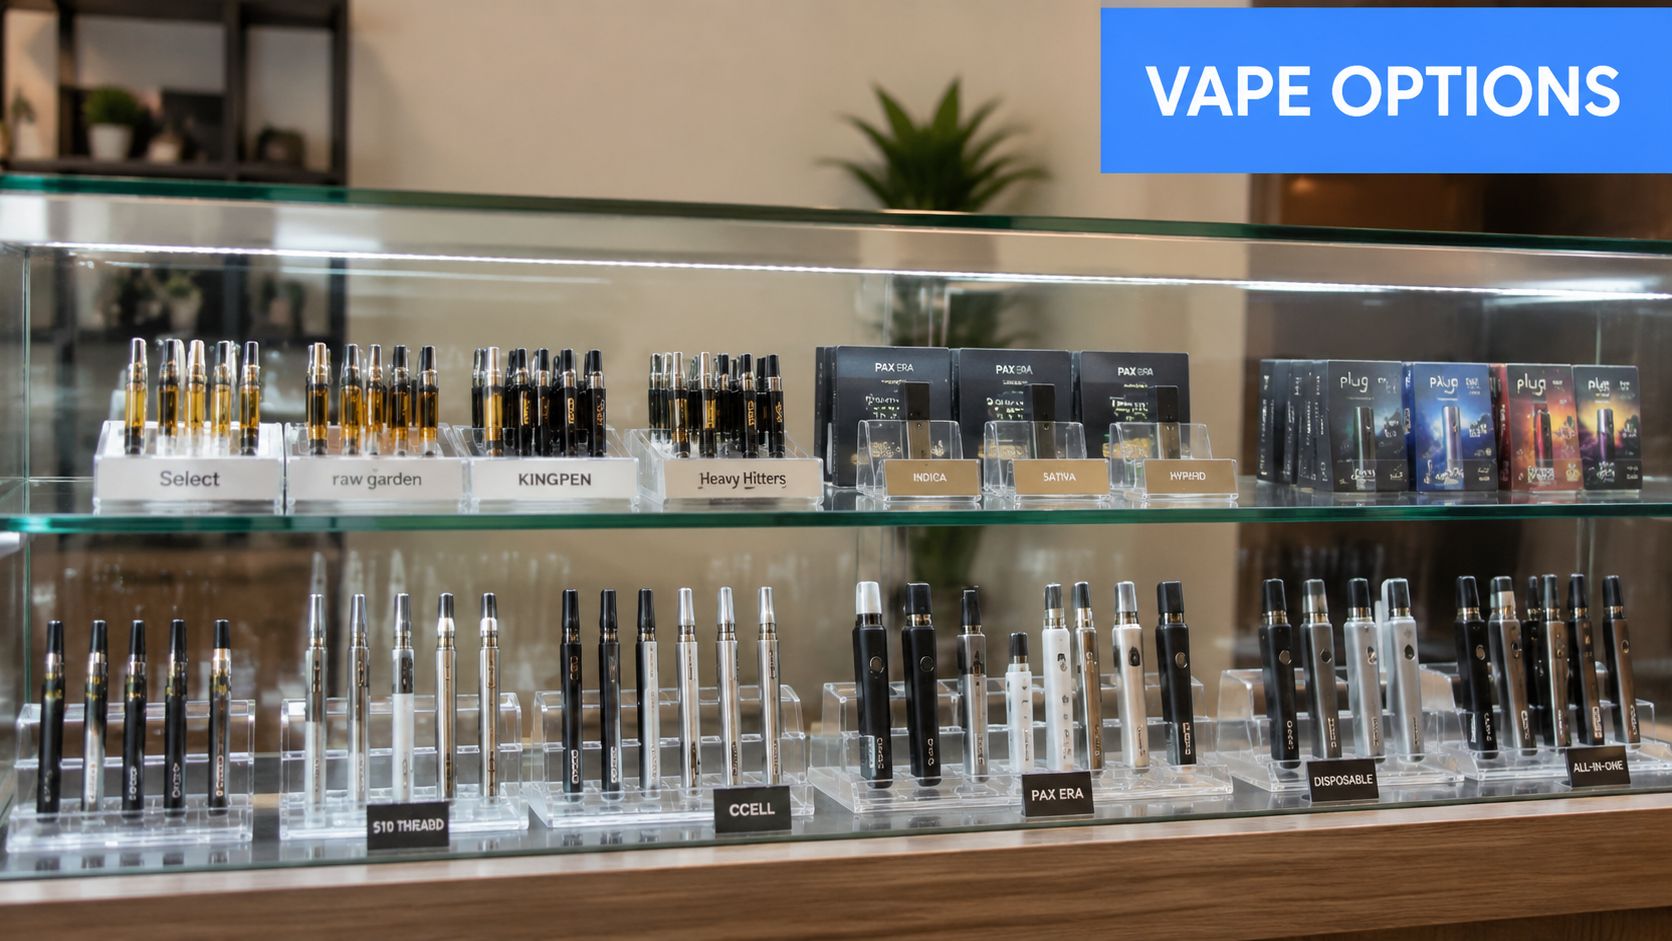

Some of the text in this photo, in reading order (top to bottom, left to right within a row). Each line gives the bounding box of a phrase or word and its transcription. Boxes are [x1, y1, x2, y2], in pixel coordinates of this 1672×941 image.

[874, 362, 915, 373] PAX ERA
[995, 364, 1015, 375] PAX
[1117, 366, 1136, 377] PAX
[1340, 371, 1369, 393] plug
[159, 470, 220, 487] Select
[332, 472, 422, 490] raw garden
[518, 472, 592, 487] KINGPEN
[699, 471, 787, 490] Heavy Hitters
[913, 472, 948, 483] INDICA
[1043, 472, 1077, 482] SATIVA
[1573, 760, 1625, 774] ALL-IN-ONE
[1314, 773, 1374, 787] DISPOSABLE
[1031, 786, 1084, 802] PAX ERA
[729, 802, 776, 817] CCELL
